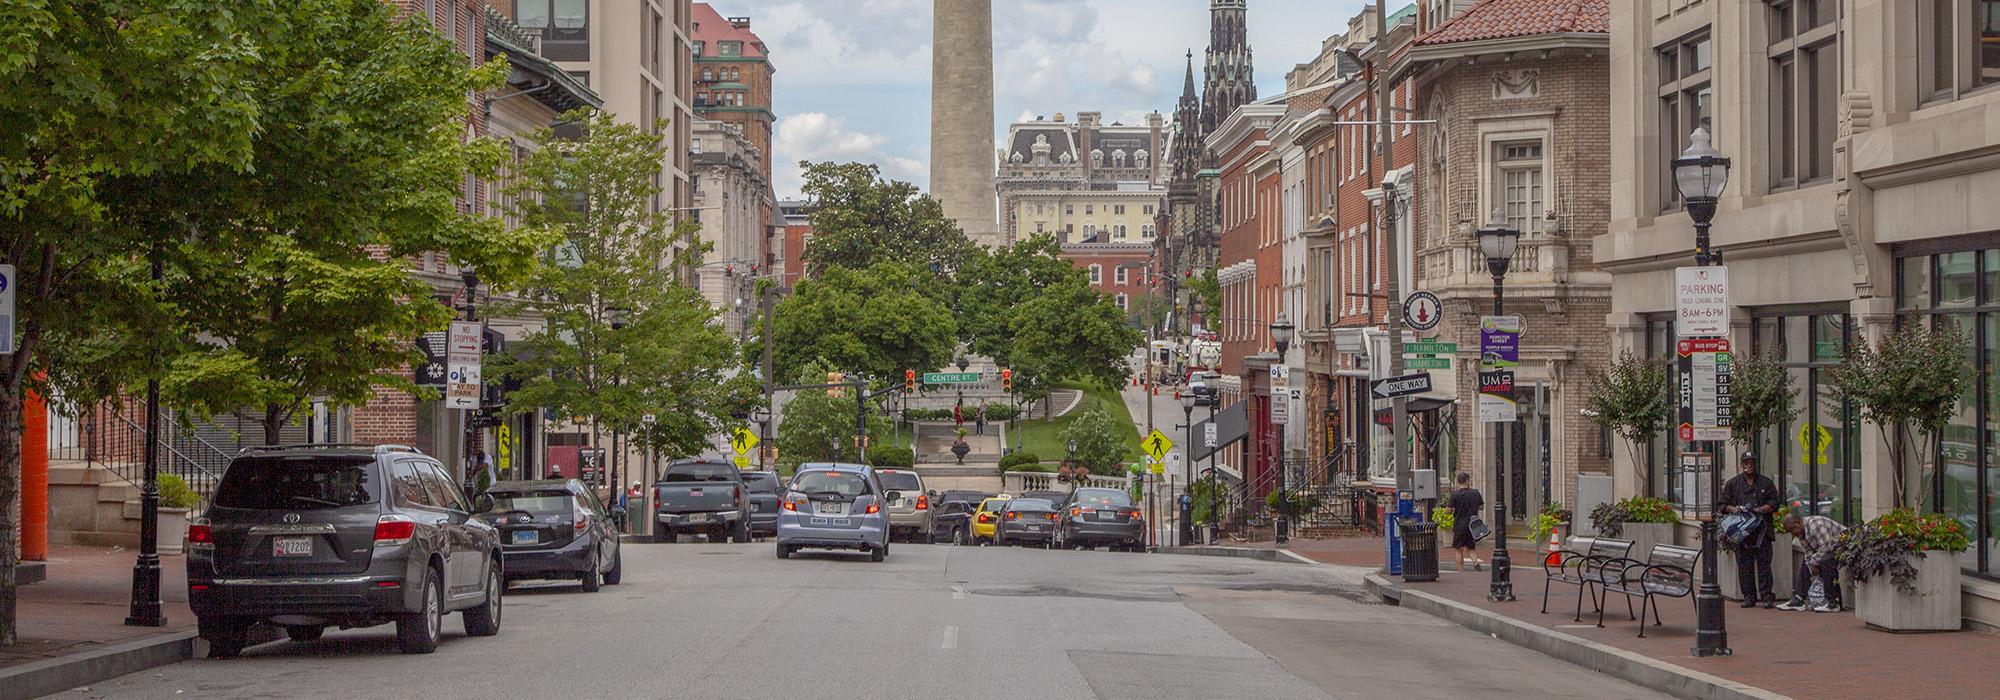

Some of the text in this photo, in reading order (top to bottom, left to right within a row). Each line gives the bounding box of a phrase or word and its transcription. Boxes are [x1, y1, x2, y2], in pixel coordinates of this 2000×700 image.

[1696, 270, 1708, 280] NO
[1681, 284, 1724, 294] PARKING
[462, 326, 470, 334] NO
[453, 335, 478, 343] STOPPING
[1413, 344, 1449, 352] HAMILTON
[931, 374, 960, 382] CENTRE
[1482, 376, 1501, 386] UM
[1719, 375, 1727, 383] 51
[1388, 379, 1425, 392] ONE WAY
[1719, 386, 1728, 394] 95
